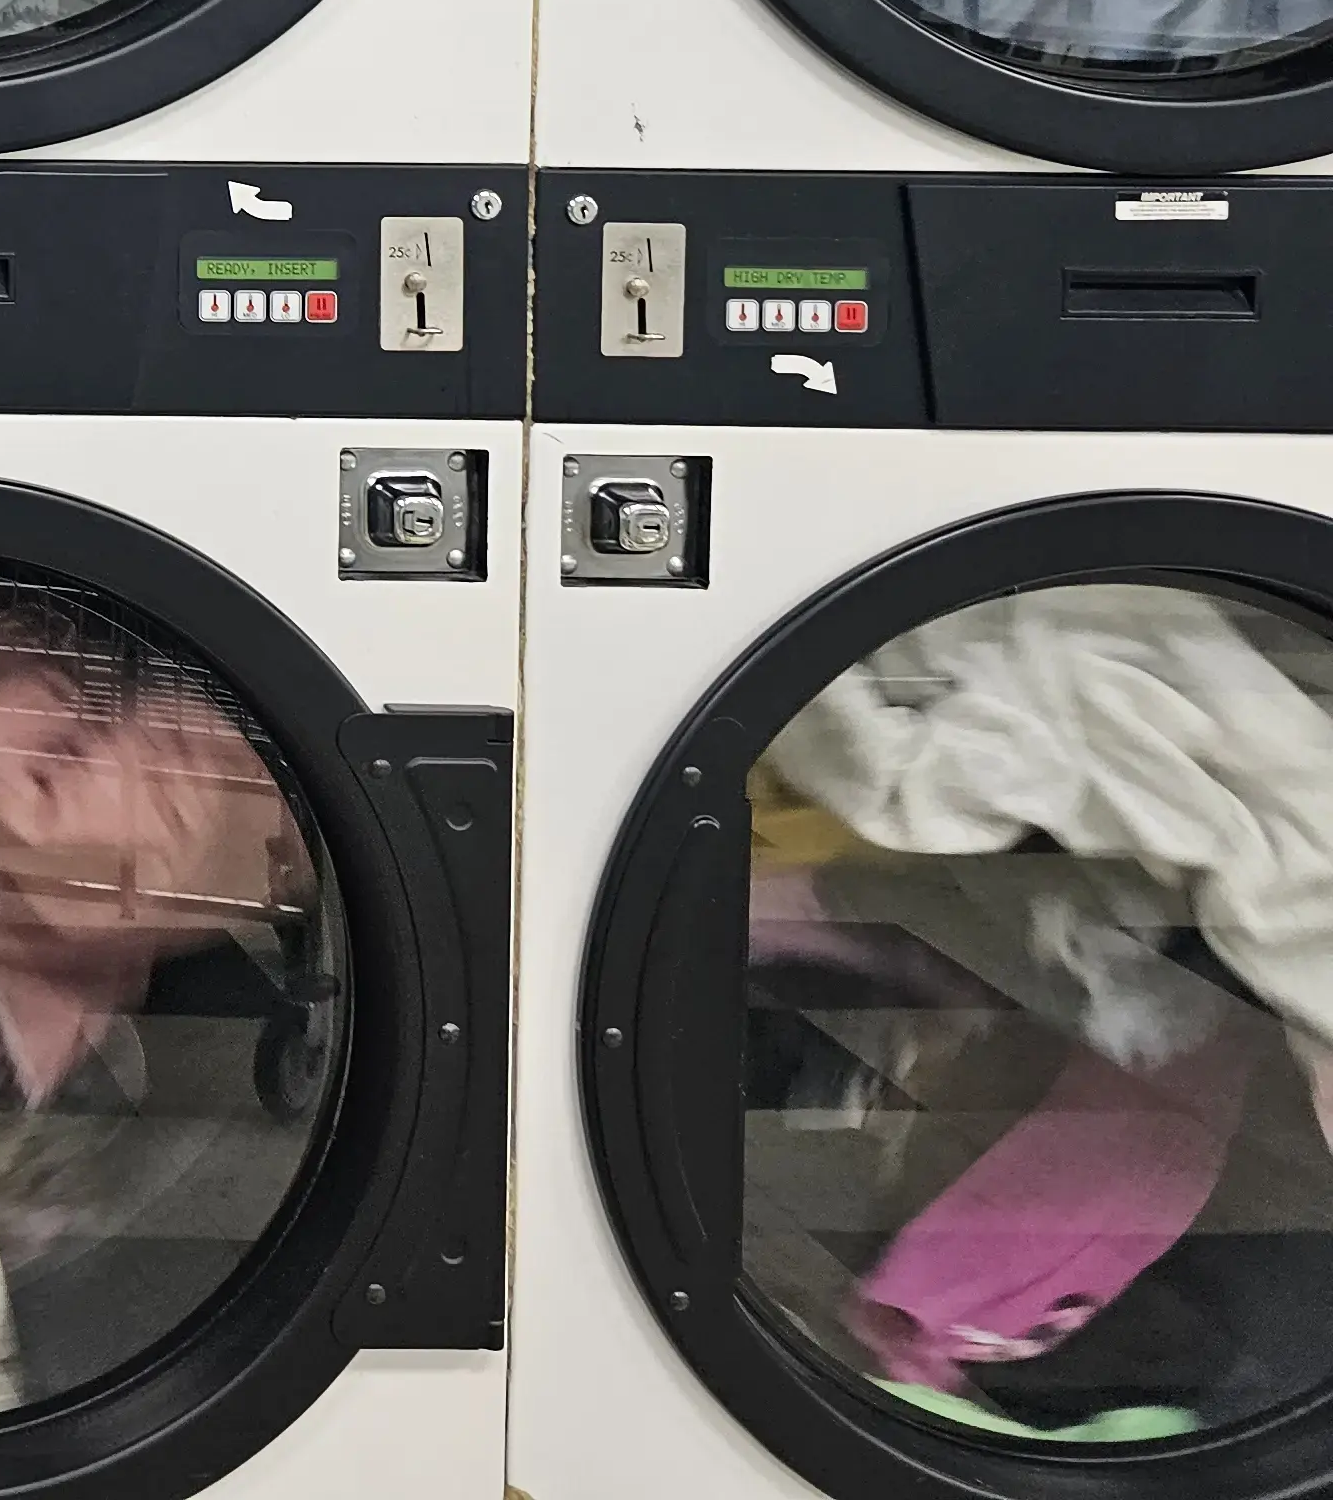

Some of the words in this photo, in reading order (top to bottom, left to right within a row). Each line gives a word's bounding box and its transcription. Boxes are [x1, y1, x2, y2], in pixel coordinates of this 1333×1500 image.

[267, 262, 318, 276] INSERT
[733, 270, 769, 284] HIGH
[776, 271, 803, 285] DRY
[812, 272, 847, 285] TEMP
